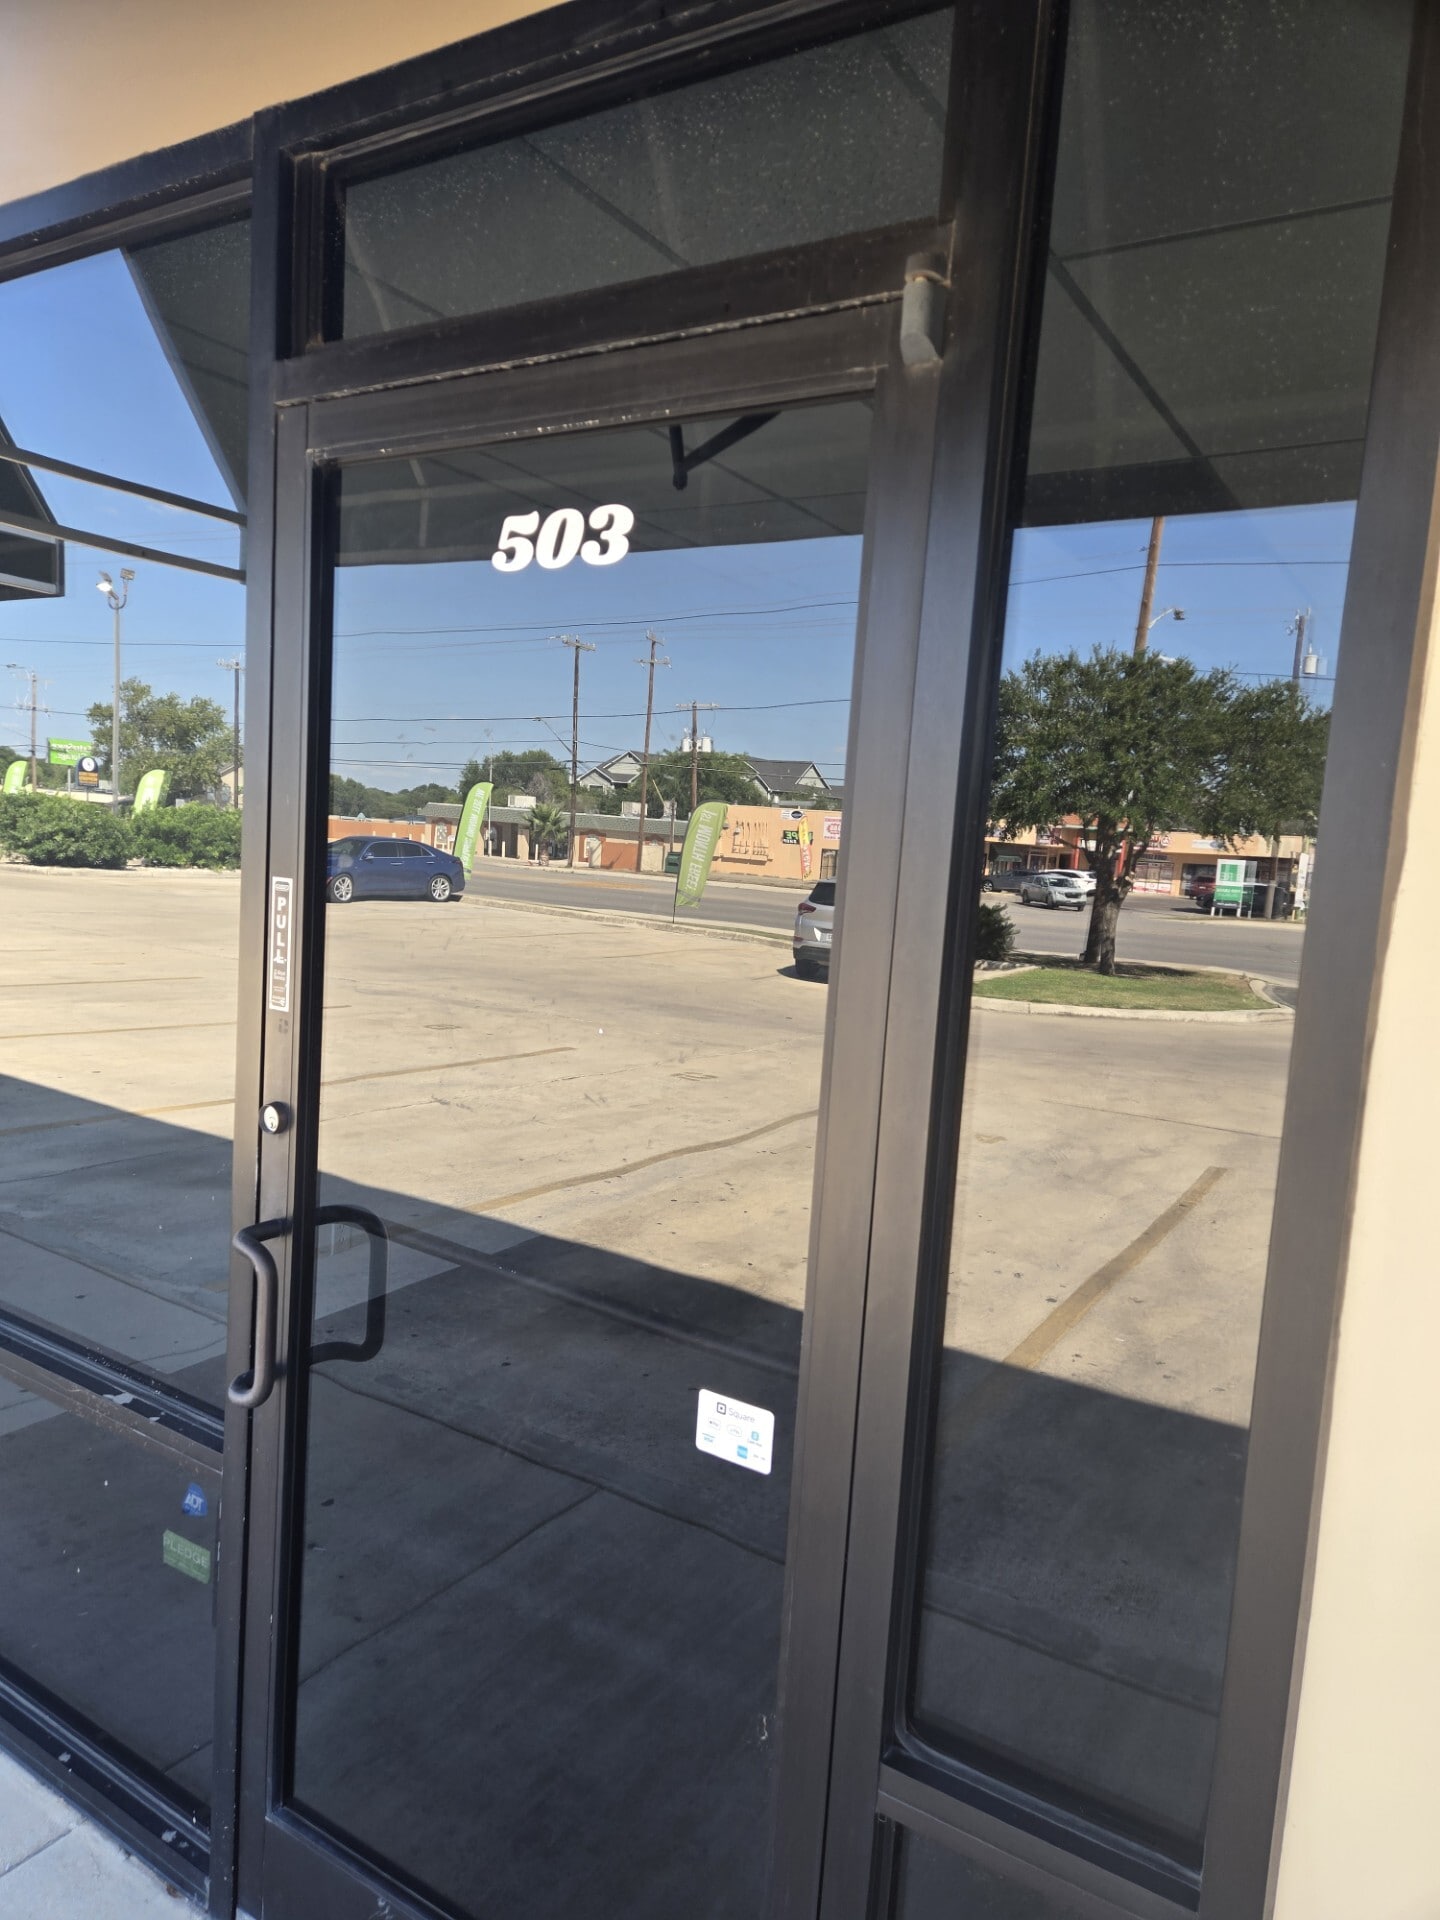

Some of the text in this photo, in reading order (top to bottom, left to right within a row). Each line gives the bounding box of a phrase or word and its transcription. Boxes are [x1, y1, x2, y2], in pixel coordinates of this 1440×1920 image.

[491, 503, 635, 572] 503
[276, 896, 287, 964] PULL
[728, 1407, 756, 1423] Square
[184, 1492, 204, 1512] ADT
[163, 1536, 208, 1569] PLEDGE
